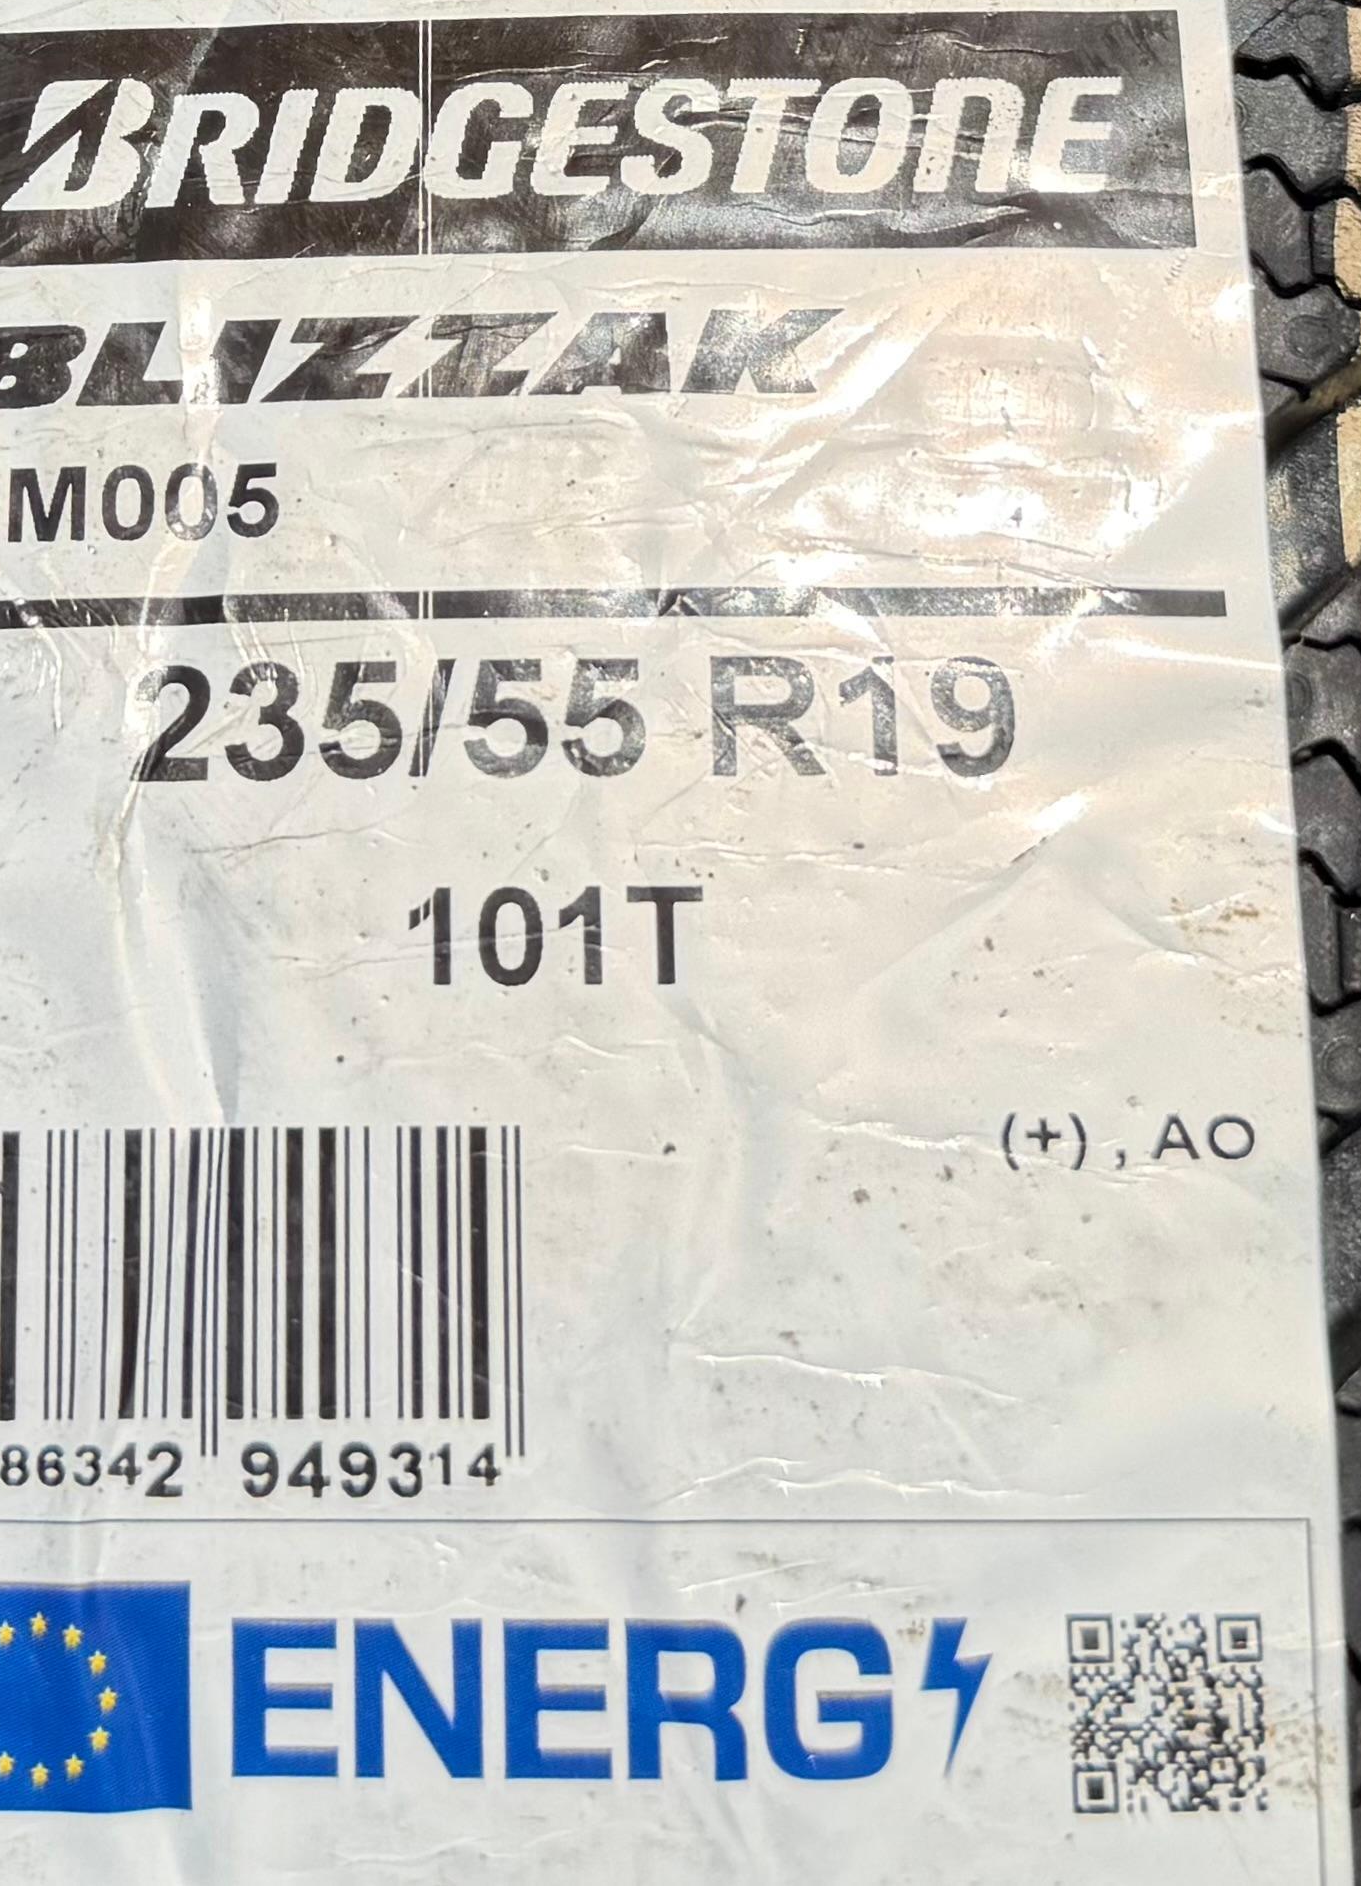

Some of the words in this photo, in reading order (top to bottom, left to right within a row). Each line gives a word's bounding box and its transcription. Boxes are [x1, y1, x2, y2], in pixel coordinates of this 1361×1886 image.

[1, 75, 1124, 212] BRIDGESTONE
[130, 657, 648, 783] 235/55
[708, 655, 1017, 779] R19
[407, 884, 705, 987] 101T
[1149, 1113, 1257, 1162] AO
[239, 1440, 503, 1500] 949314
[231, 1621, 896, 1783] ENERG
